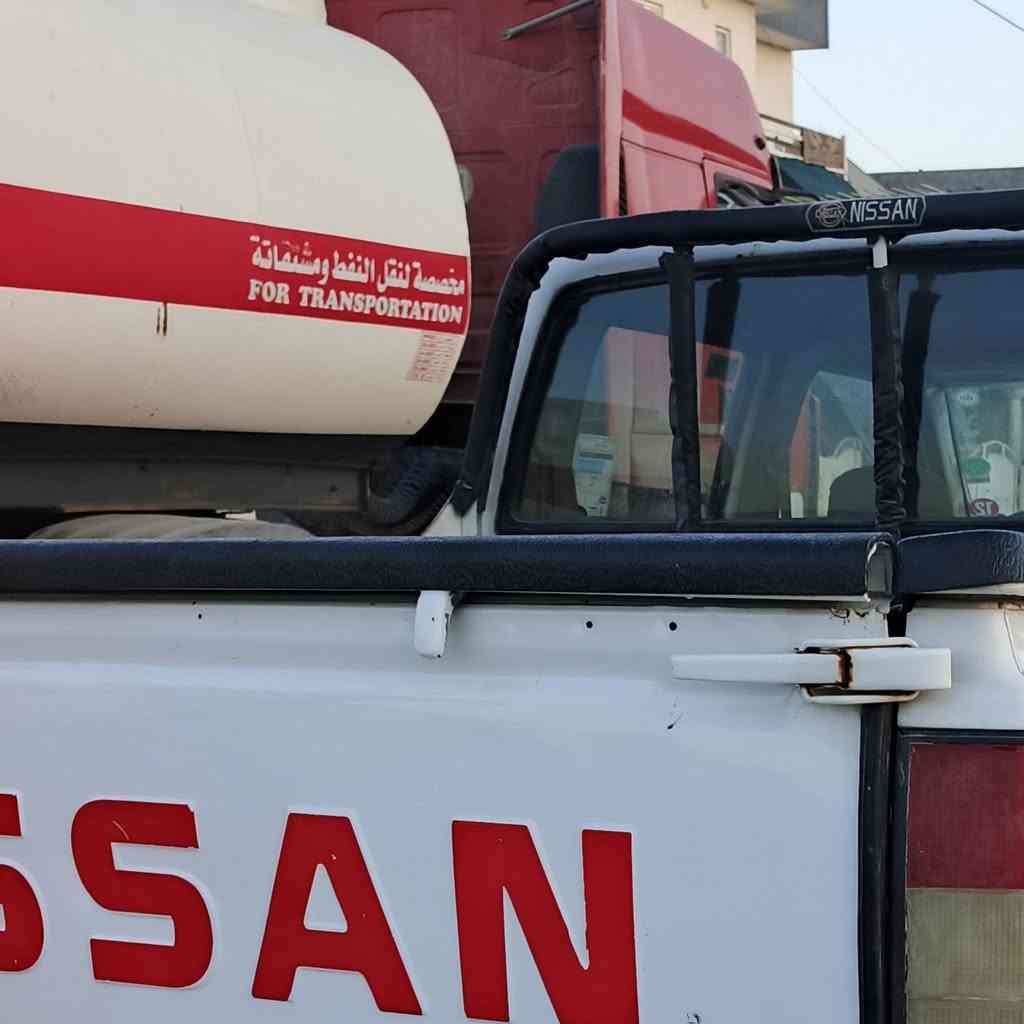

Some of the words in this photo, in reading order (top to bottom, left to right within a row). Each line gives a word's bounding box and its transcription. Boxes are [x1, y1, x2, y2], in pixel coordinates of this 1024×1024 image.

[849, 198, 919, 223] NISSAN
[332, 250, 376, 284] النفط
[376, 258, 411, 293] لنقل
[413, 260, 465, 296] مخصصة
[247, 279, 291, 304] FOR
[298, 285, 464, 324] TRANSPORTATION
